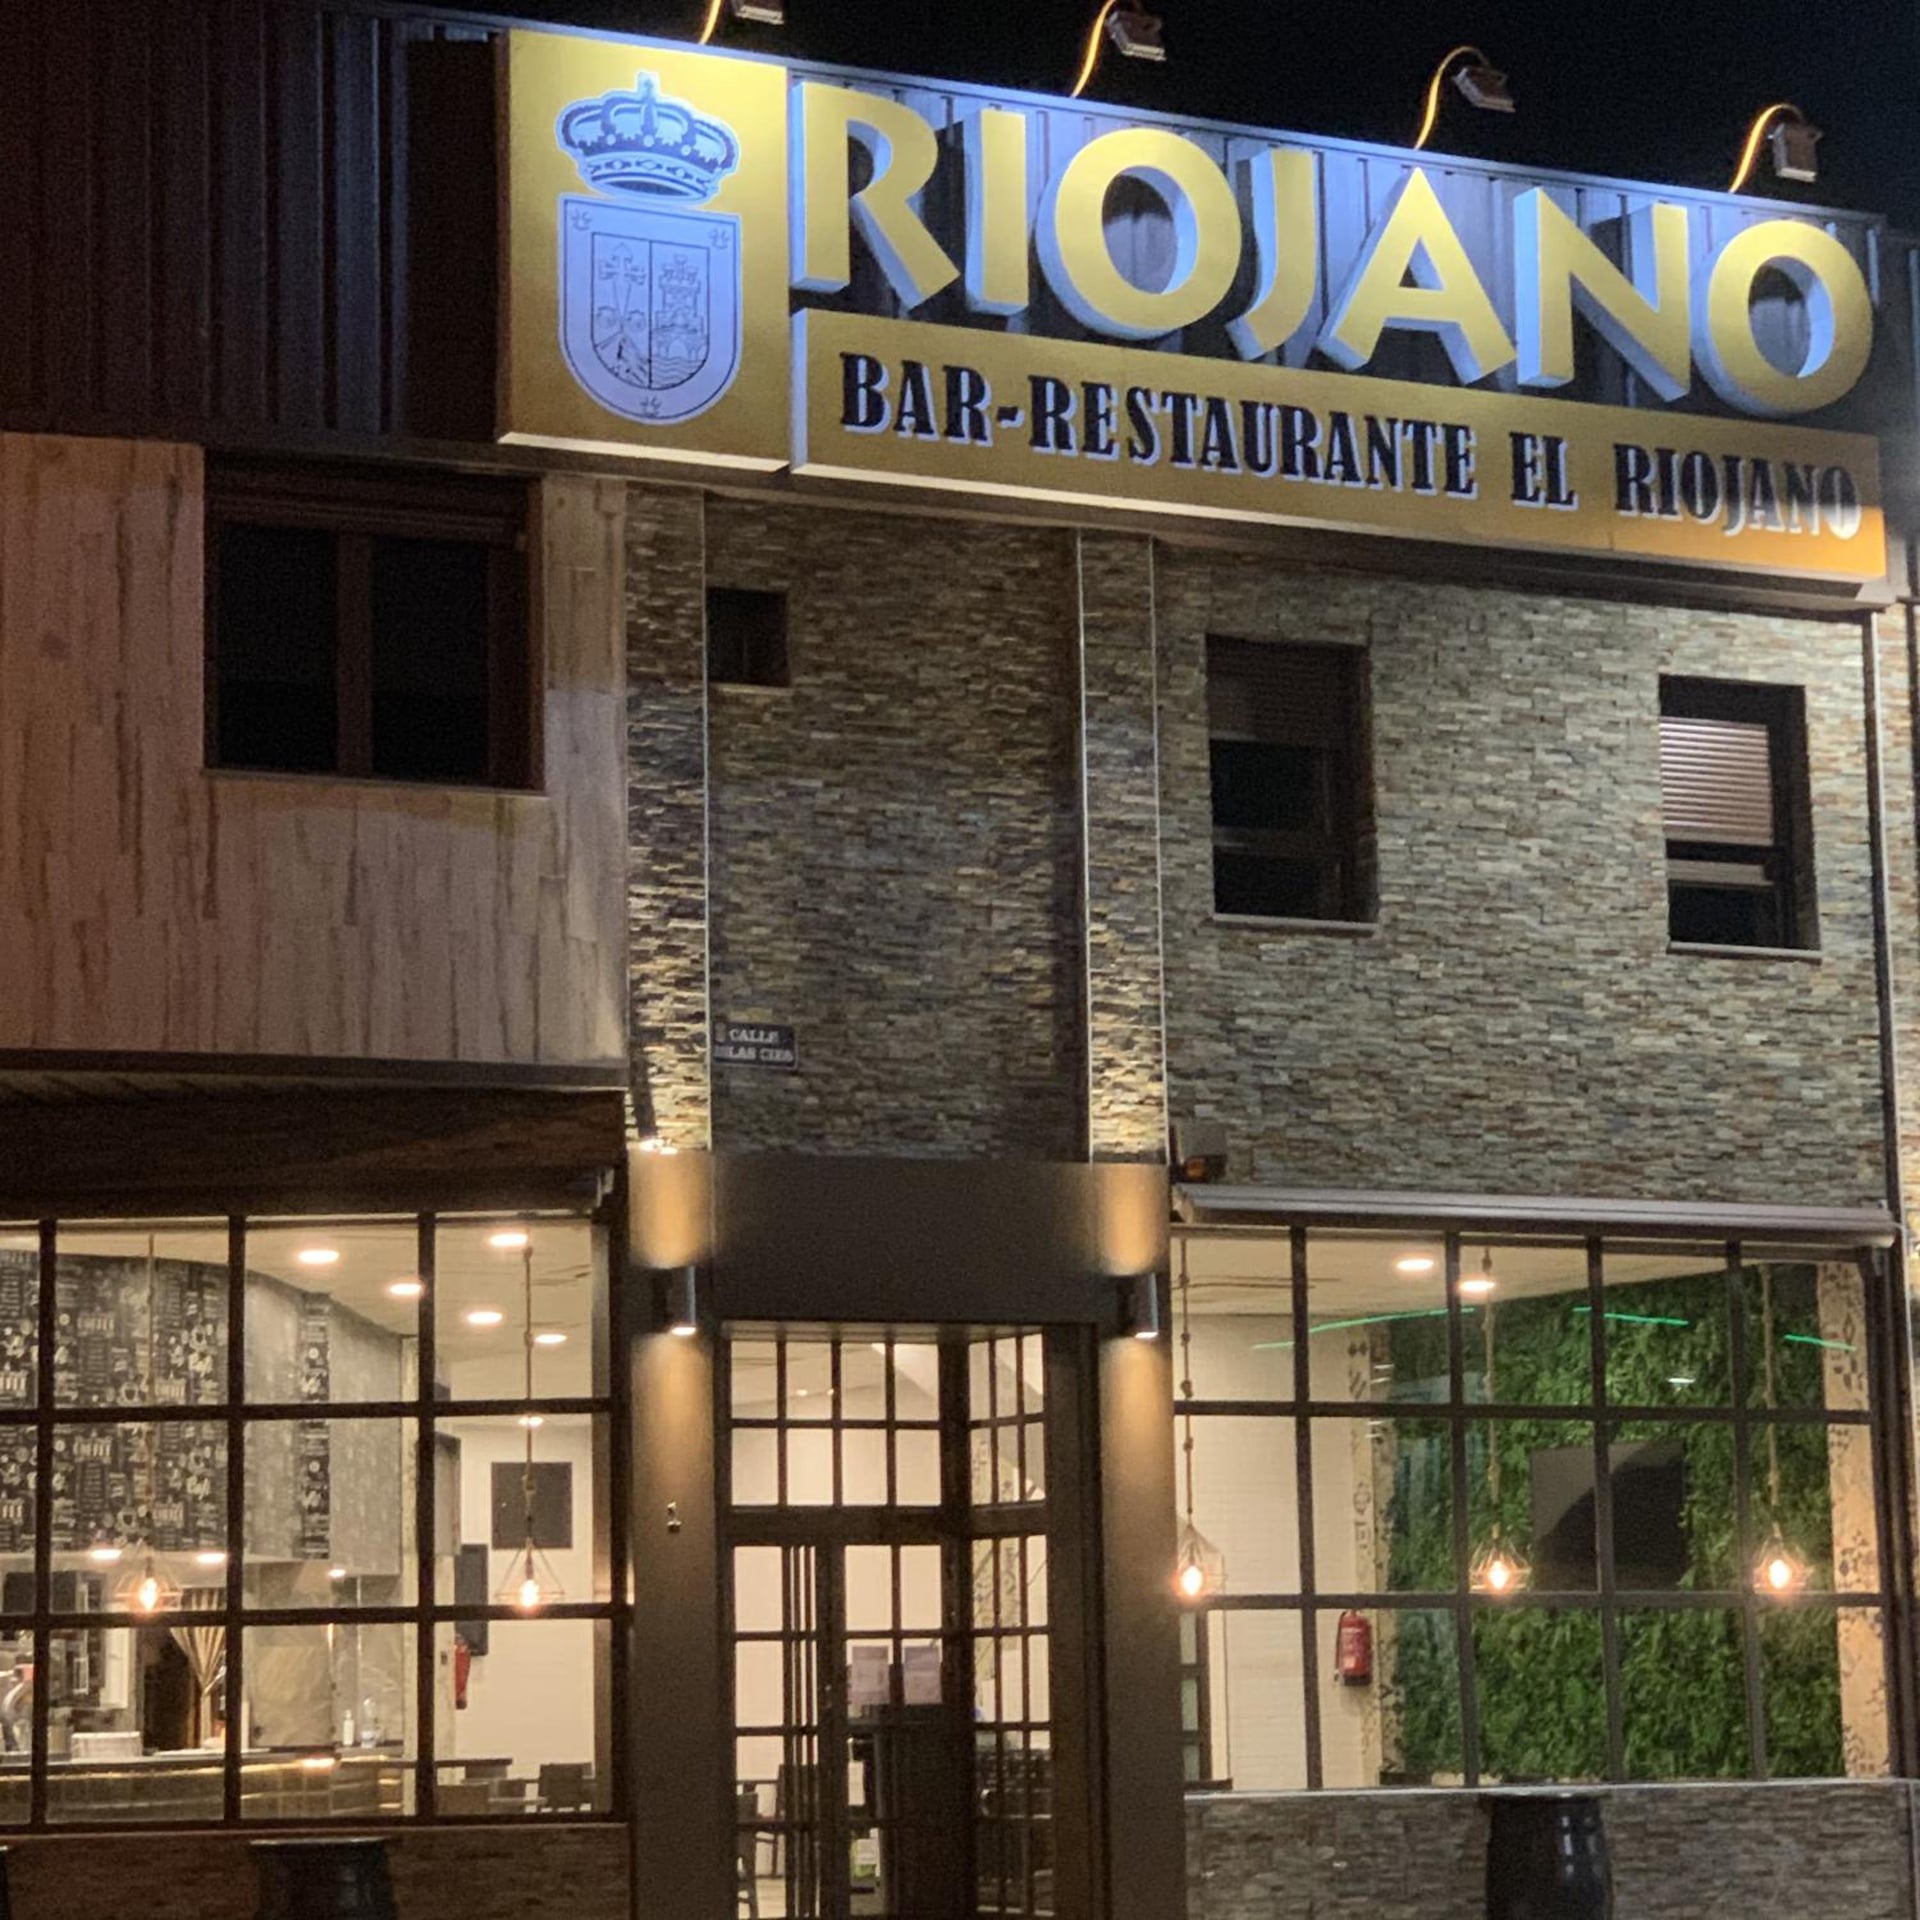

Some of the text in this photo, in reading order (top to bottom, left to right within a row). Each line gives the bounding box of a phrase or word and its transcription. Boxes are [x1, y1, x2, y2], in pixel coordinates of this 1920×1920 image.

[793, 81, 1874, 416] RIOJANO
[840, 351, 1863, 540] BAR-RESTAURANTE EL RIOJANO
[729, 1028, 779, 1043] CALLE
